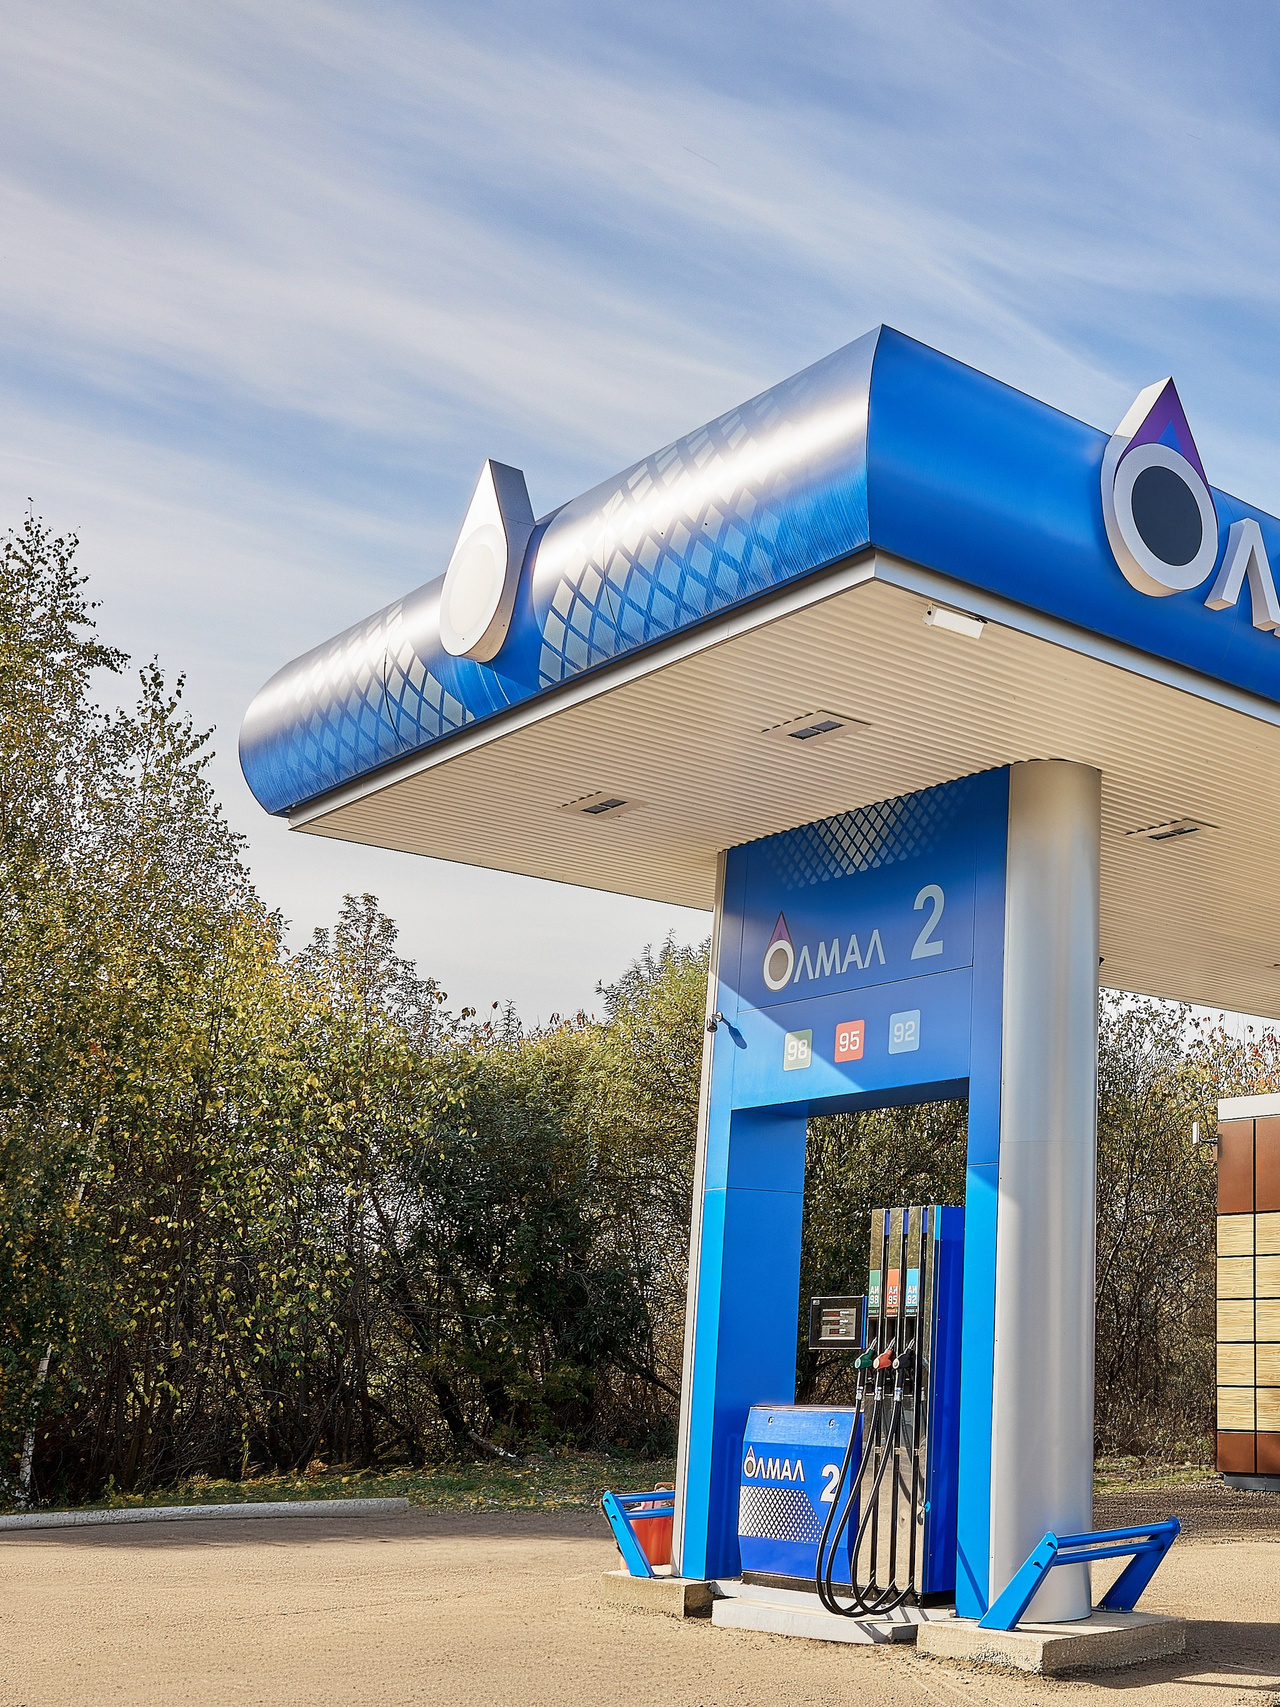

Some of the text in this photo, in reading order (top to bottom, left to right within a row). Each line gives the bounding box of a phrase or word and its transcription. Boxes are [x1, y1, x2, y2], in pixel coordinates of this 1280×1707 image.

[911, 884, 945, 960] 2
[787, 1020, 916, 1061] 98 95 92
[869, 1295, 879, 1305] 98
[888, 1295, 898, 1305] 95
[907, 1295, 917, 1305] 92
[820, 1464, 841, 1502] 2
